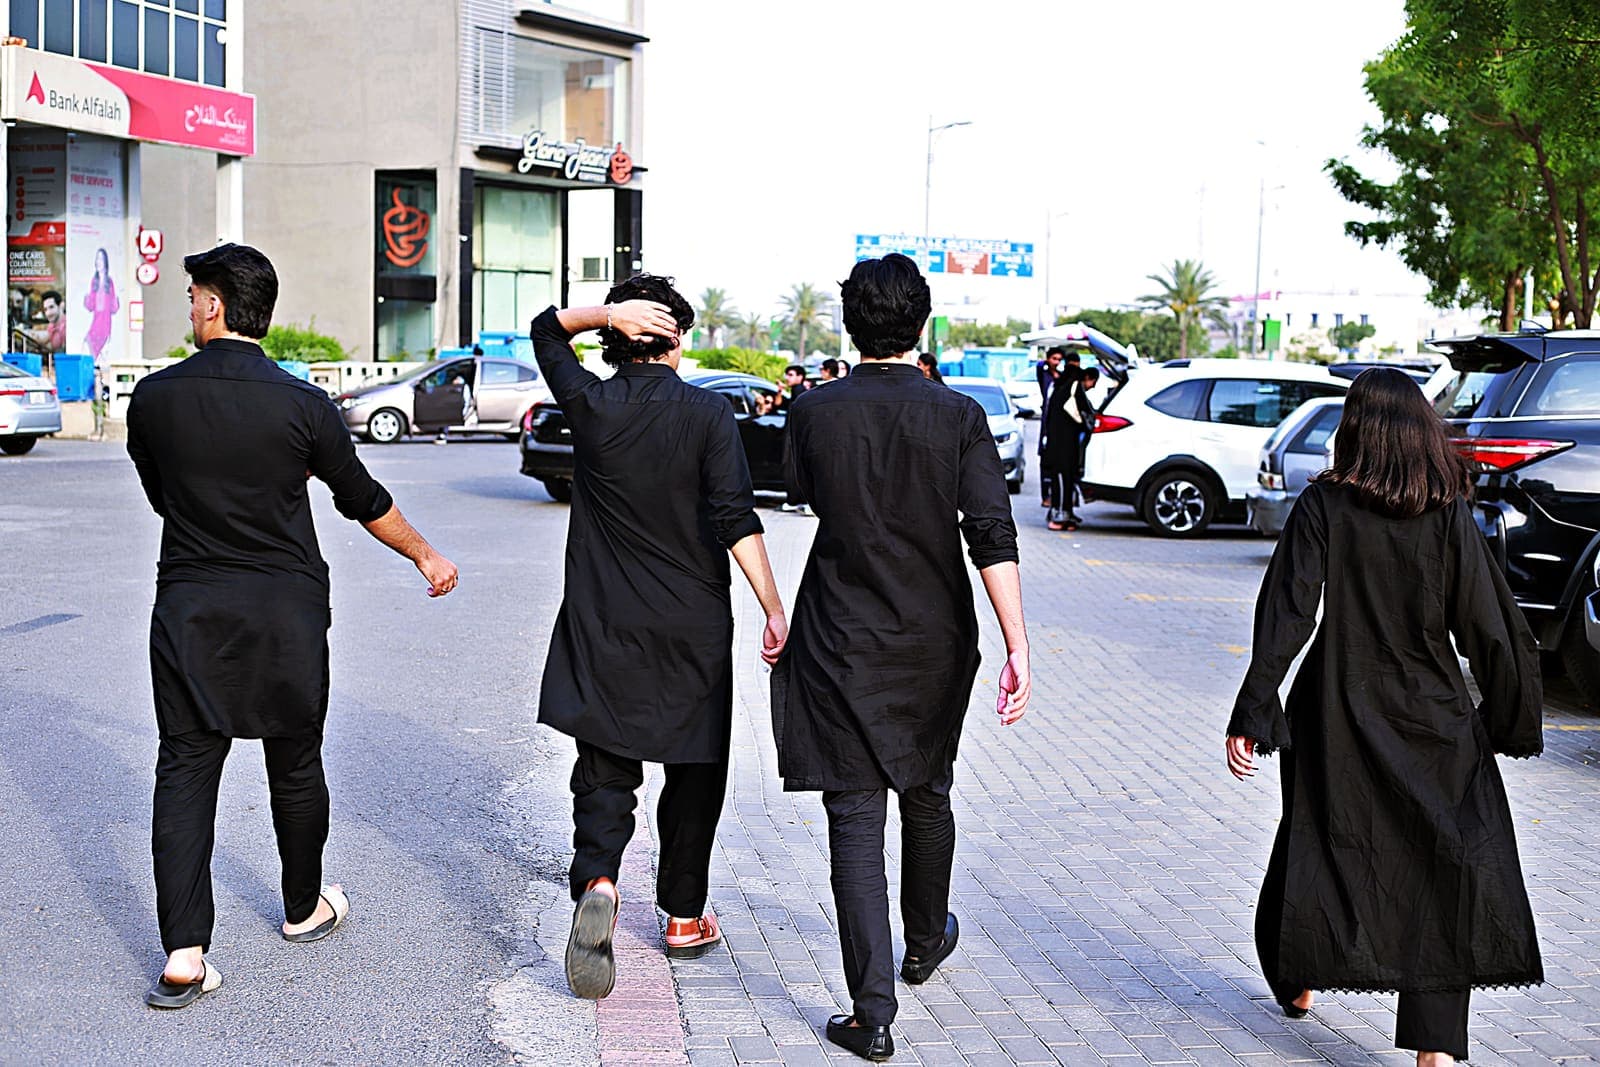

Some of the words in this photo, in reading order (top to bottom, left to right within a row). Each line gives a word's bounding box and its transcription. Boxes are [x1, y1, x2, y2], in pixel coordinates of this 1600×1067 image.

[49, 90, 79, 113] Bank
[81, 97, 121, 121] Alfalah
[71, 174, 85, 186] FREE
[10, 251, 25, 260] ONE
